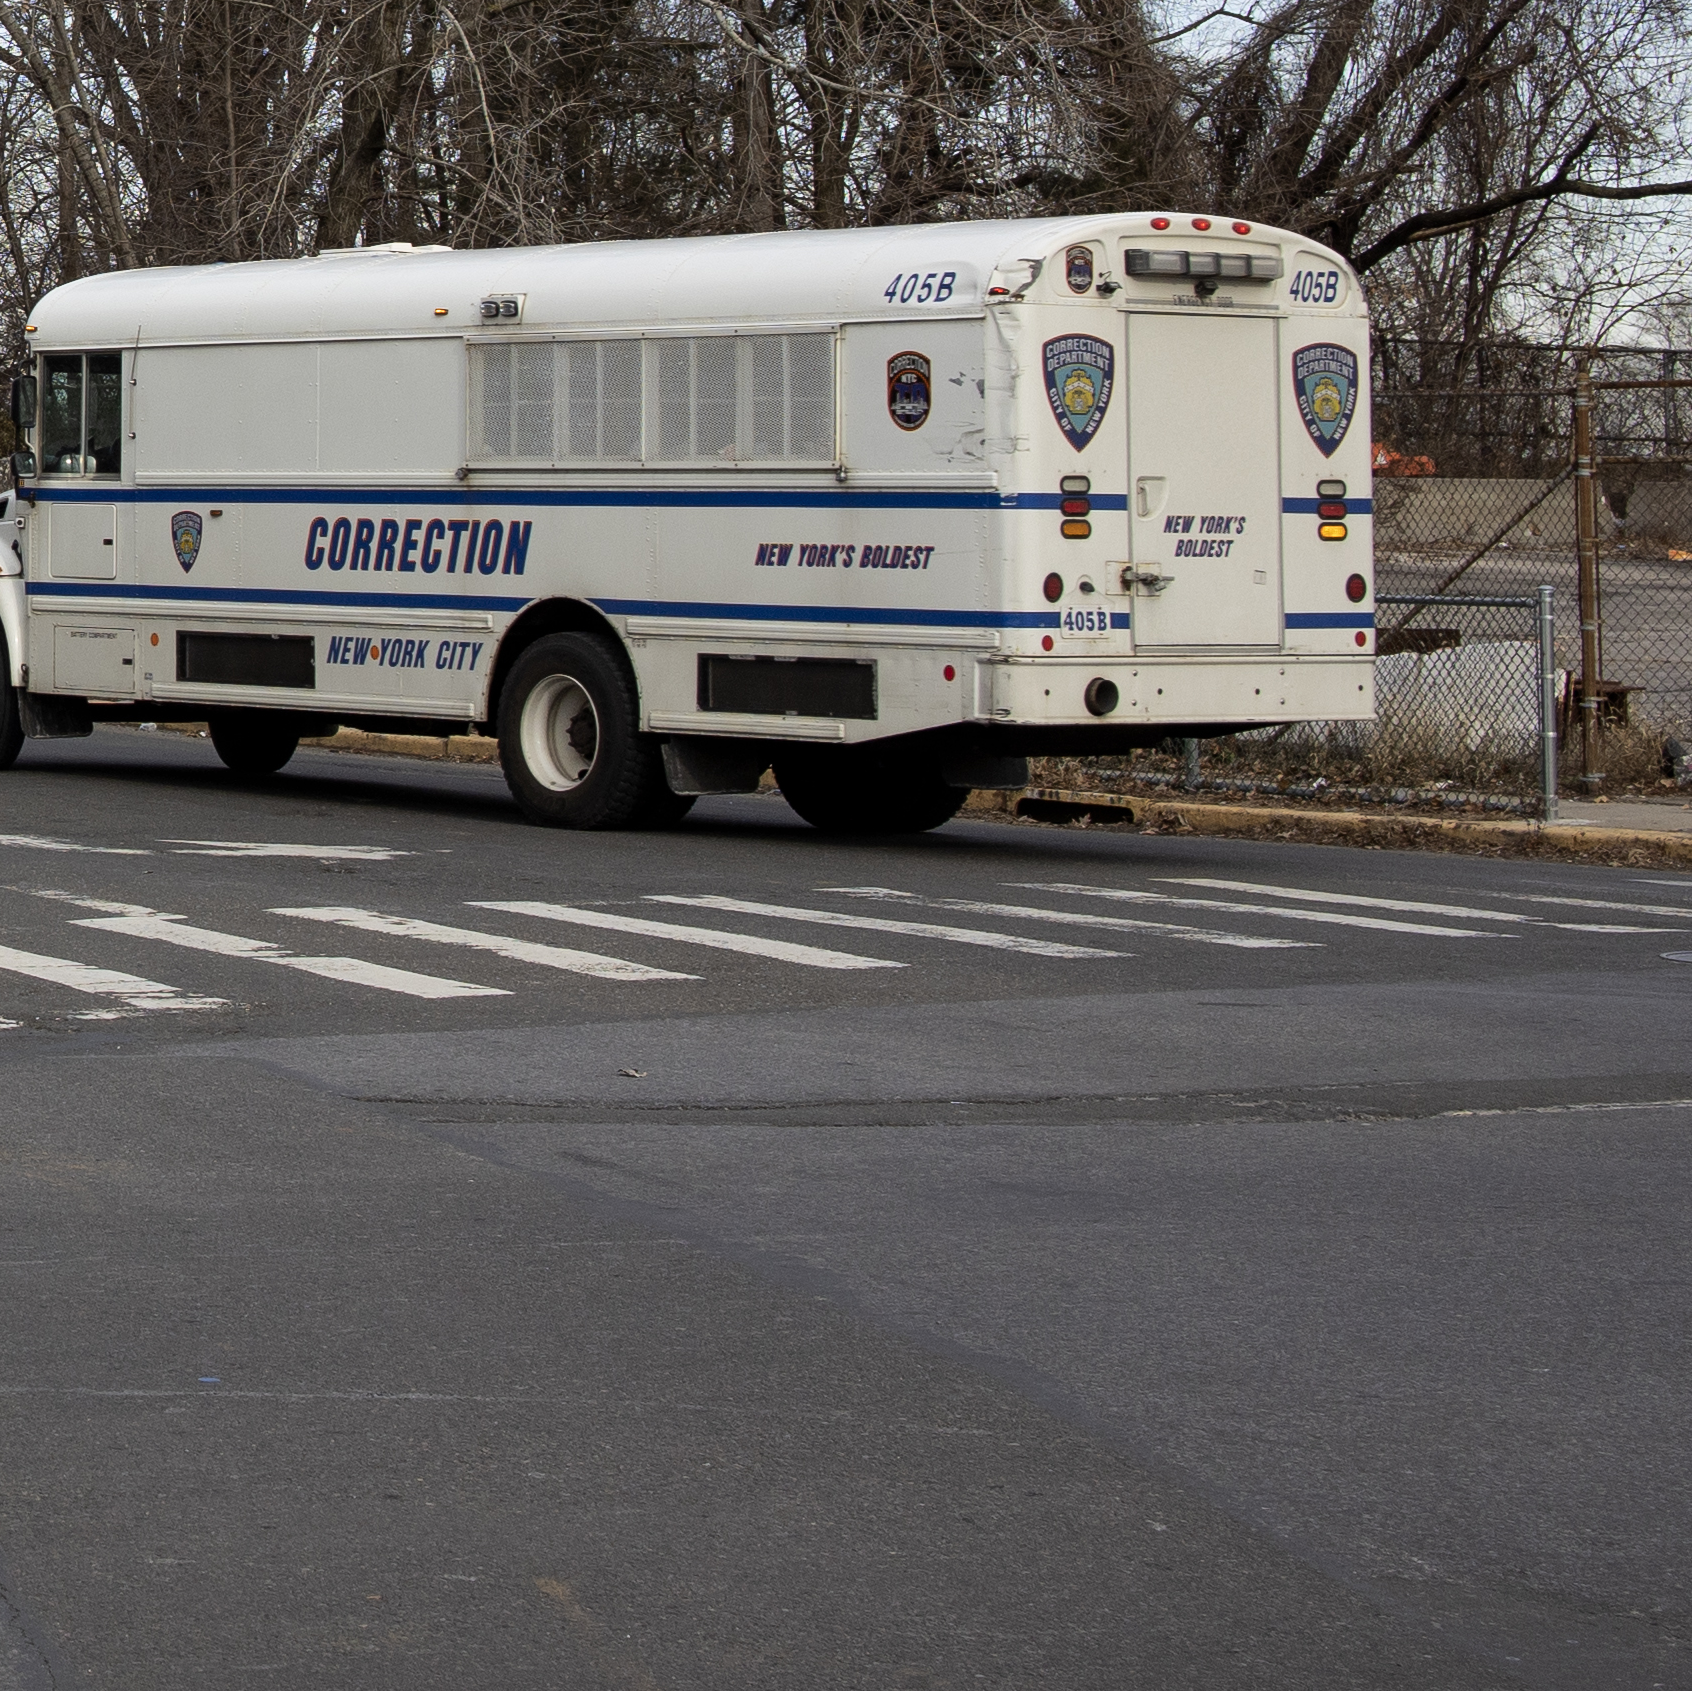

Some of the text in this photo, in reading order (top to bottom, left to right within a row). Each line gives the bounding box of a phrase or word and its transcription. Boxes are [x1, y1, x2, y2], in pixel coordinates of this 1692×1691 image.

[883, 271, 956, 304] 405B
[1289, 270, 1339, 303] 405B
[1046, 338, 1110, 359] CORRECTION
[1296, 347, 1354, 368] CORRECTION
[889, 354, 929, 378] CORRECTION
[1047, 351, 1110, 372] DEPARTMENT
[1297, 360, 1354, 380] DEPARTMENT
[901, 373, 918, 384] NYC
[1049, 387, 1072, 431] CITY OF
[1085, 378, 1112, 434] NEW YORK
[1299, 395, 1321, 437] CITY OF
[1333, 387, 1356, 440] NEW YORK
[1163, 515, 1247, 535] NEW YORK'S
[304, 516, 533, 576] CORRECTION
[754, 543, 935, 570] NEW YORK'S BOLDEST
[1174, 539, 1234, 558] BOLDEST
[1063, 611, 1107, 631] 405B
[326, 635, 485, 671] NEW YORK CITY
